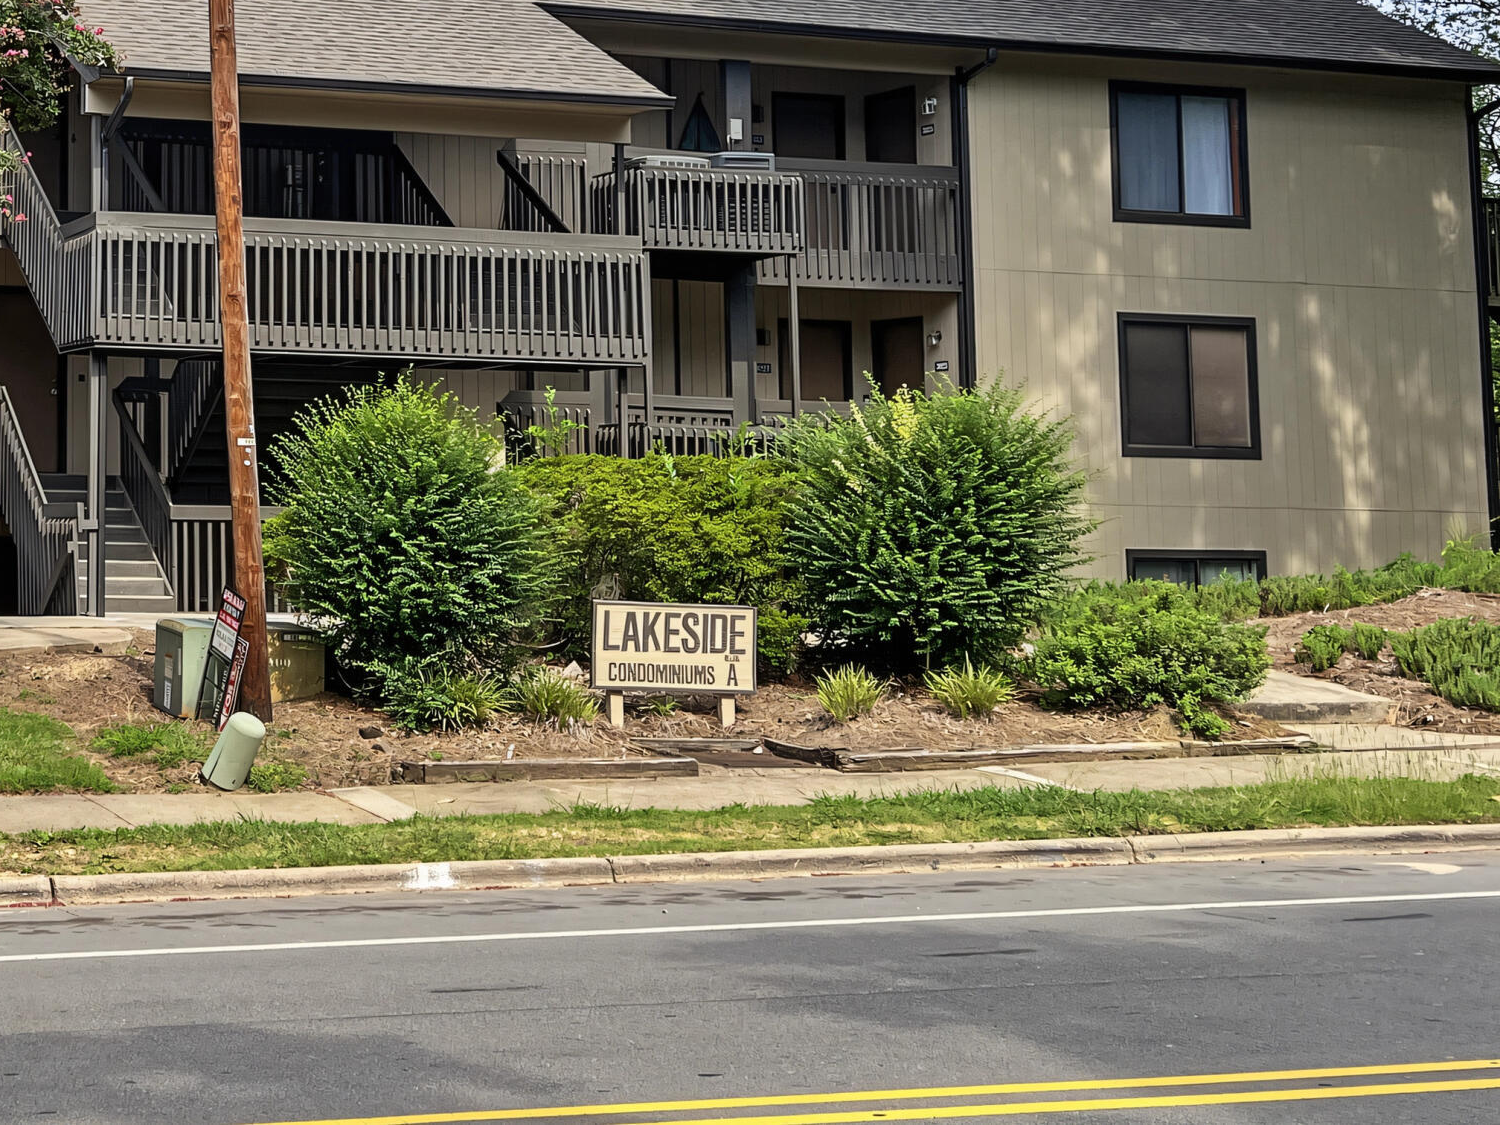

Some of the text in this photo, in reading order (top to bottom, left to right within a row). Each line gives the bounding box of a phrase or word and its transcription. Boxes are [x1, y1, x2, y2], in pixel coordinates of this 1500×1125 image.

[603, 610, 746, 654] LAKESIDE
[608, 662, 738, 687] CONDOMINIUMS A
